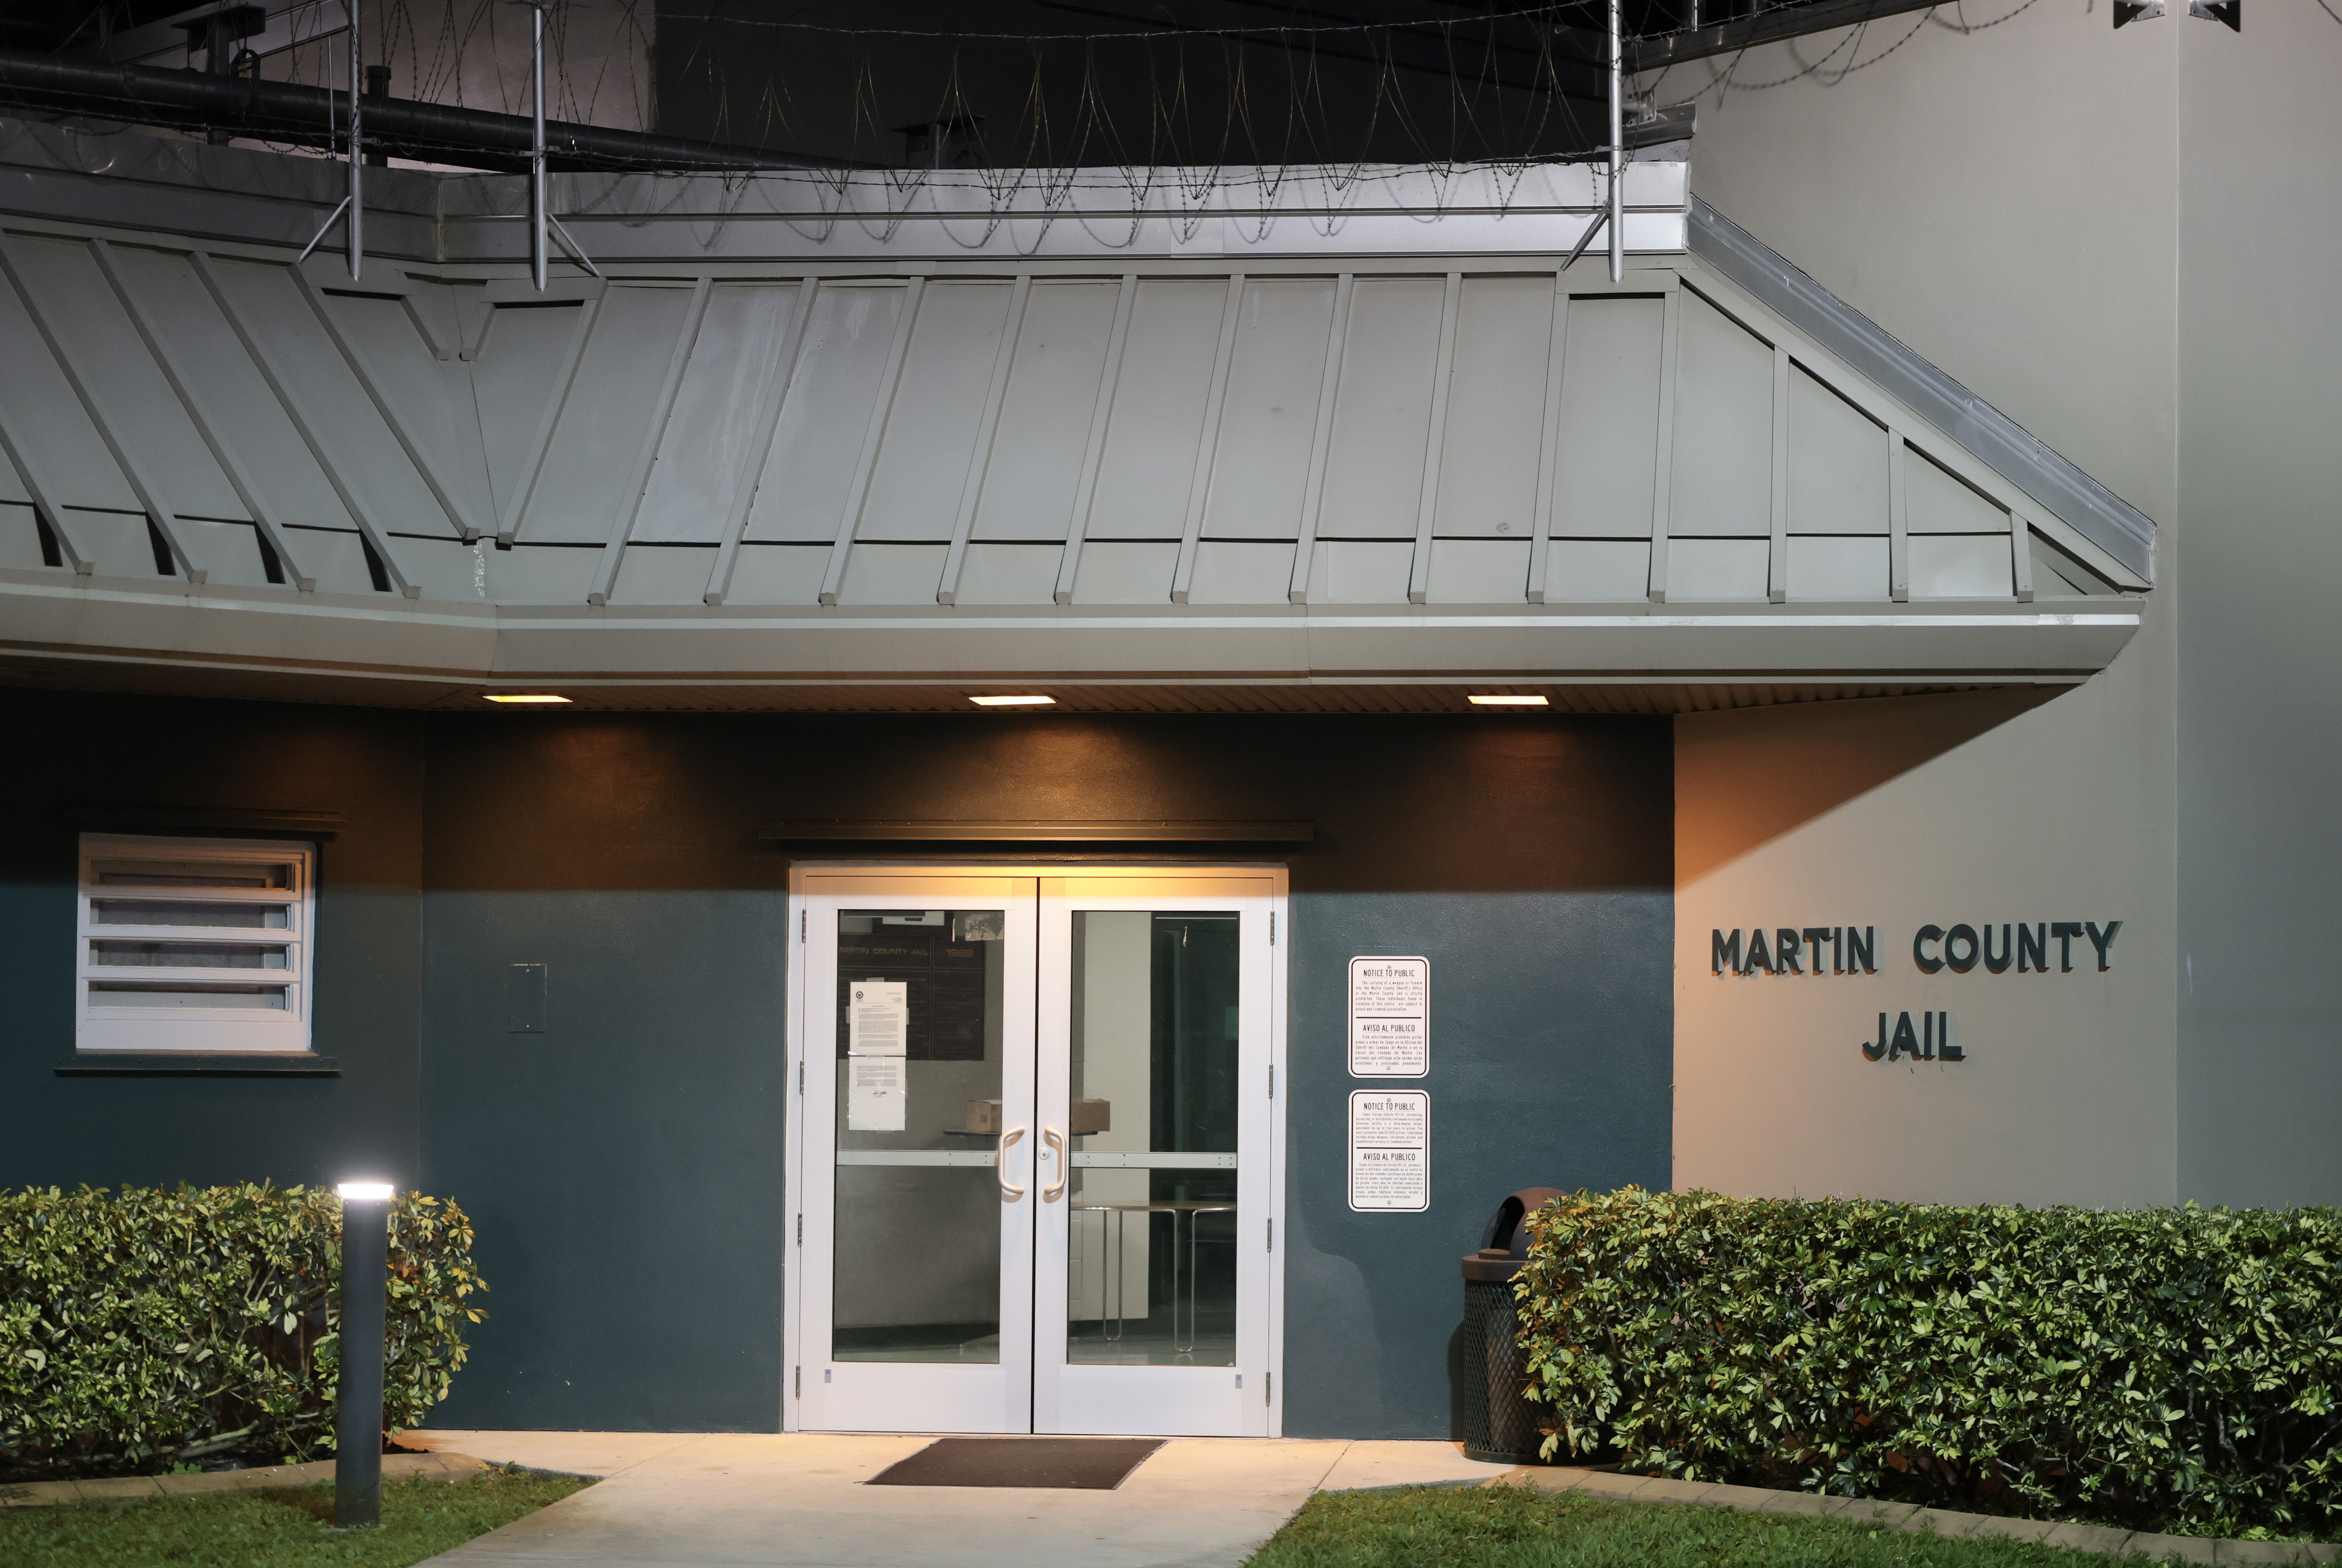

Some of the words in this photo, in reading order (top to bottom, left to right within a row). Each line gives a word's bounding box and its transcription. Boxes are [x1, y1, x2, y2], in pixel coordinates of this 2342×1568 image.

[1712, 926, 1878, 976] MARTIN
[1913, 921, 2123, 974] COUNTY
[1862, 1011, 1966, 1062] JAIL
